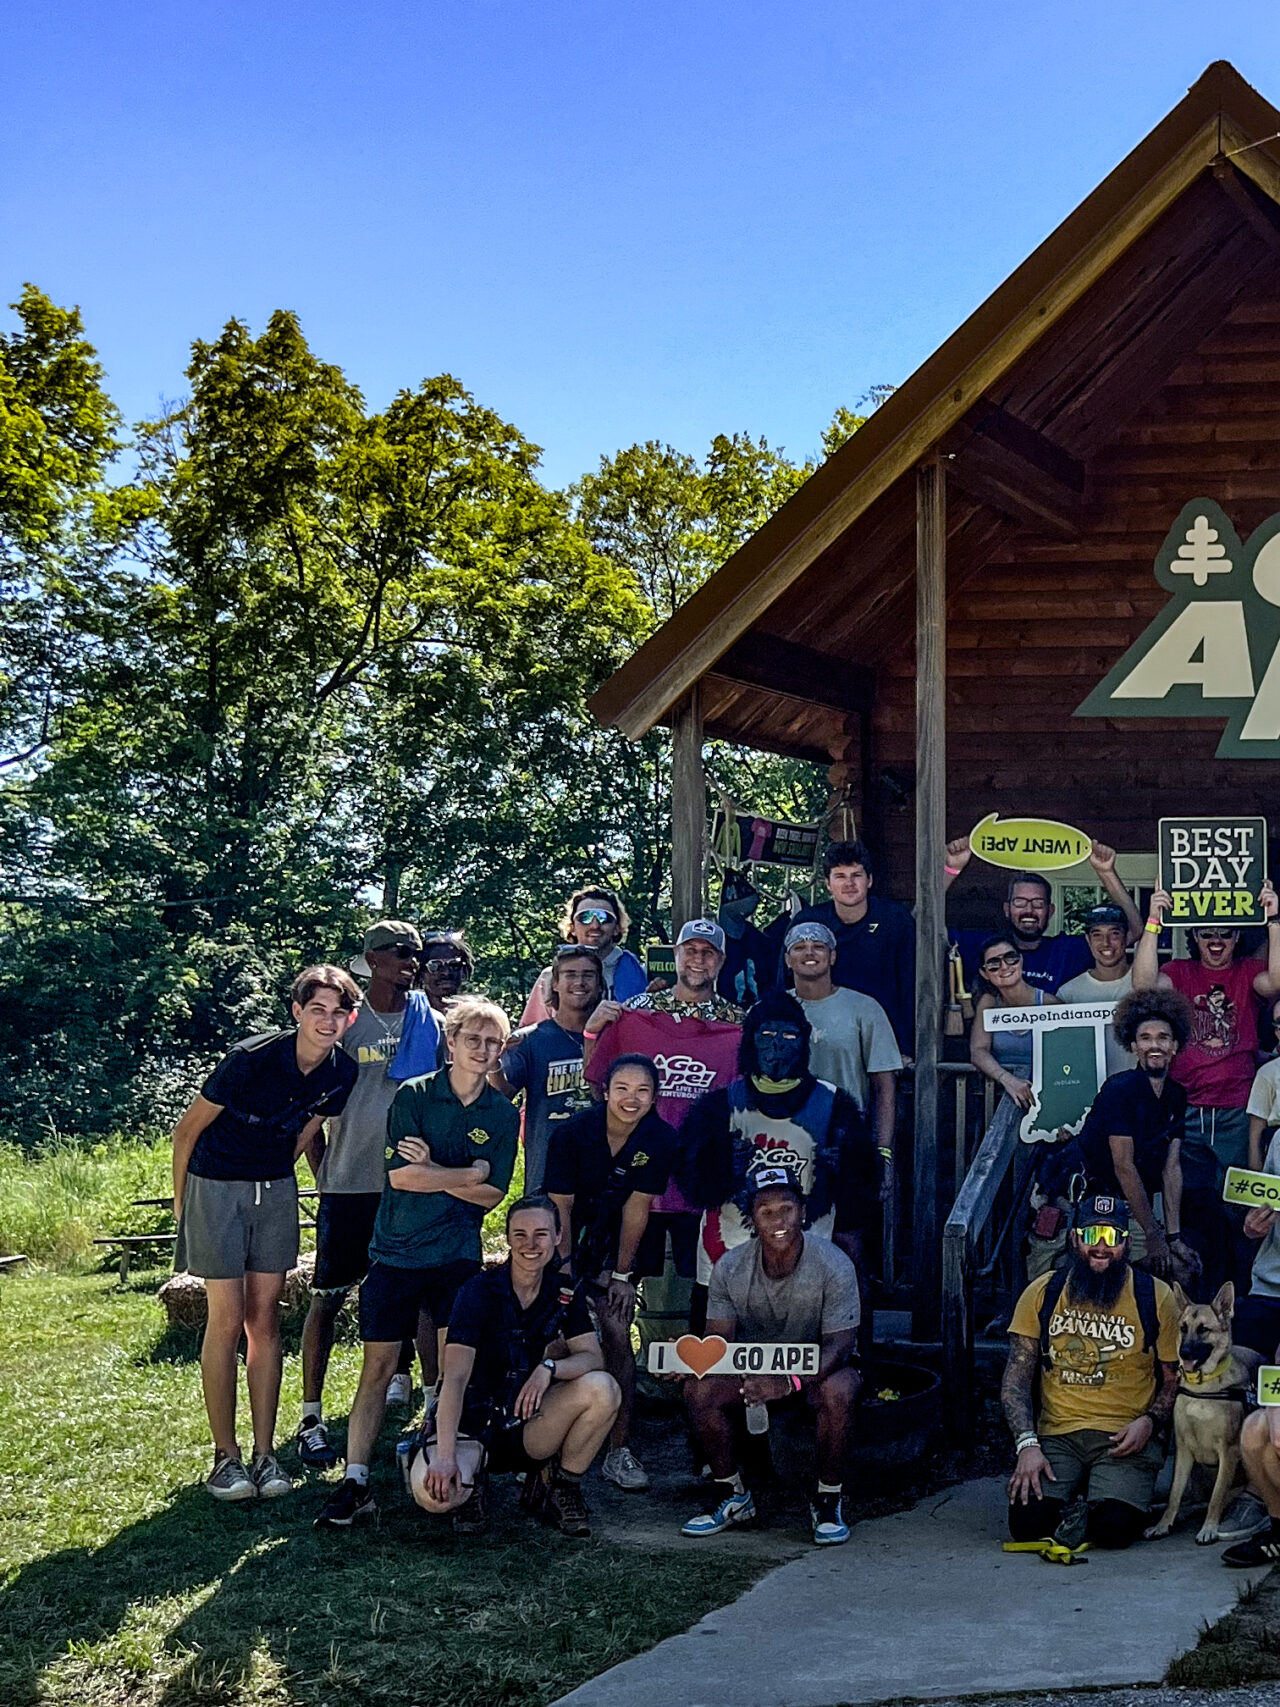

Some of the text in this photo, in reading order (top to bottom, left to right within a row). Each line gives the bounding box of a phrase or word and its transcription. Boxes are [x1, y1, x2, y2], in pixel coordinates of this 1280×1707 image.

[981, 836, 1081, 855] I WENT APE!
[1170, 827, 1254, 857] BEST
[1170, 856, 1254, 889] DAY
[1171, 890, 1255, 917] EVER
[648, 961, 676, 972] WELCO
[991, 1008, 1118, 1025] #GoApeIndianapo
[667, 1058, 704, 1073] Go
[1063, 1308, 1126, 1326] SAVANNAH
[1048, 1313, 1136, 1348] BANANAS
[657, 1345, 815, 1371] I GO APE
